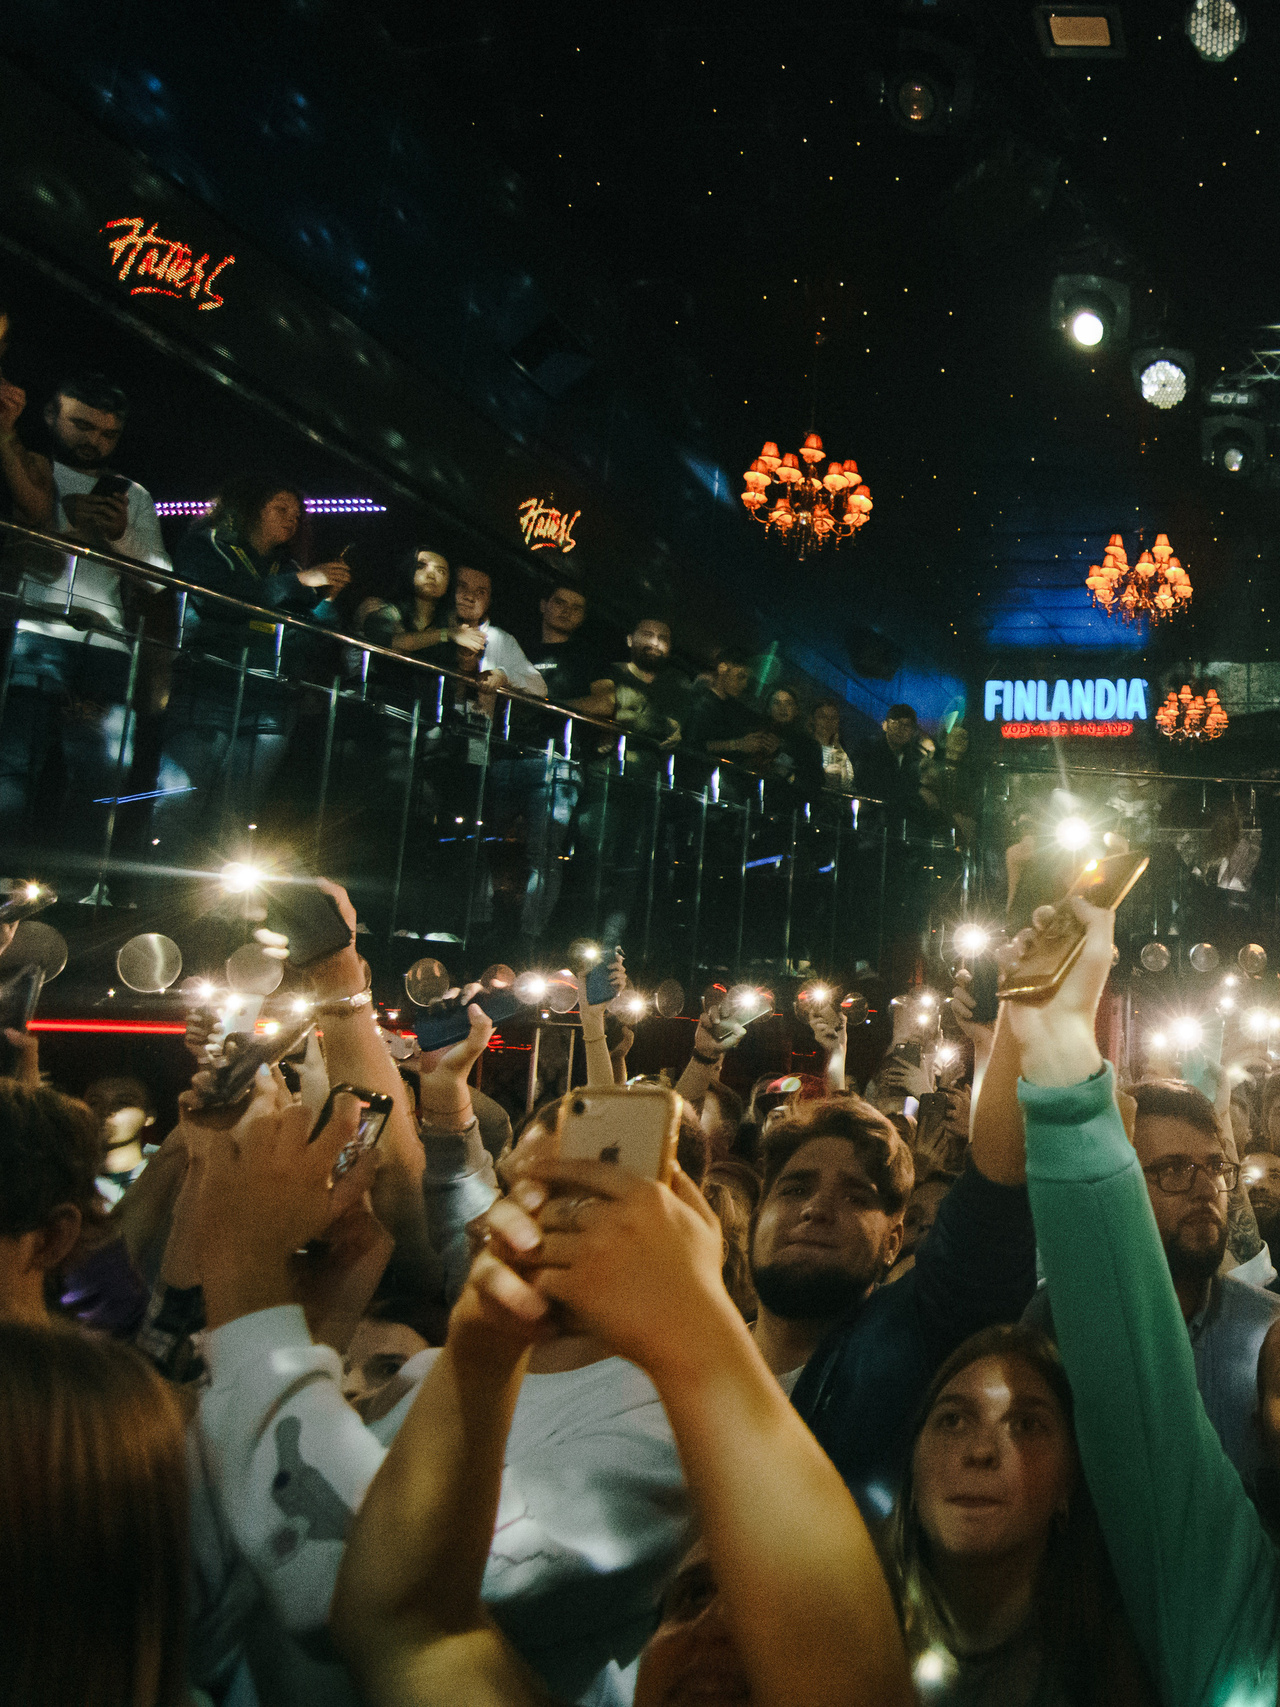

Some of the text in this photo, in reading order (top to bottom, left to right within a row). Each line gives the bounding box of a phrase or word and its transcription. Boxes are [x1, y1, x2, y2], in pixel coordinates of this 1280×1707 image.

[984, 678, 1148, 722] FINLANDIA
[1002, 723, 1131, 736] VODKA OF FINLAND
